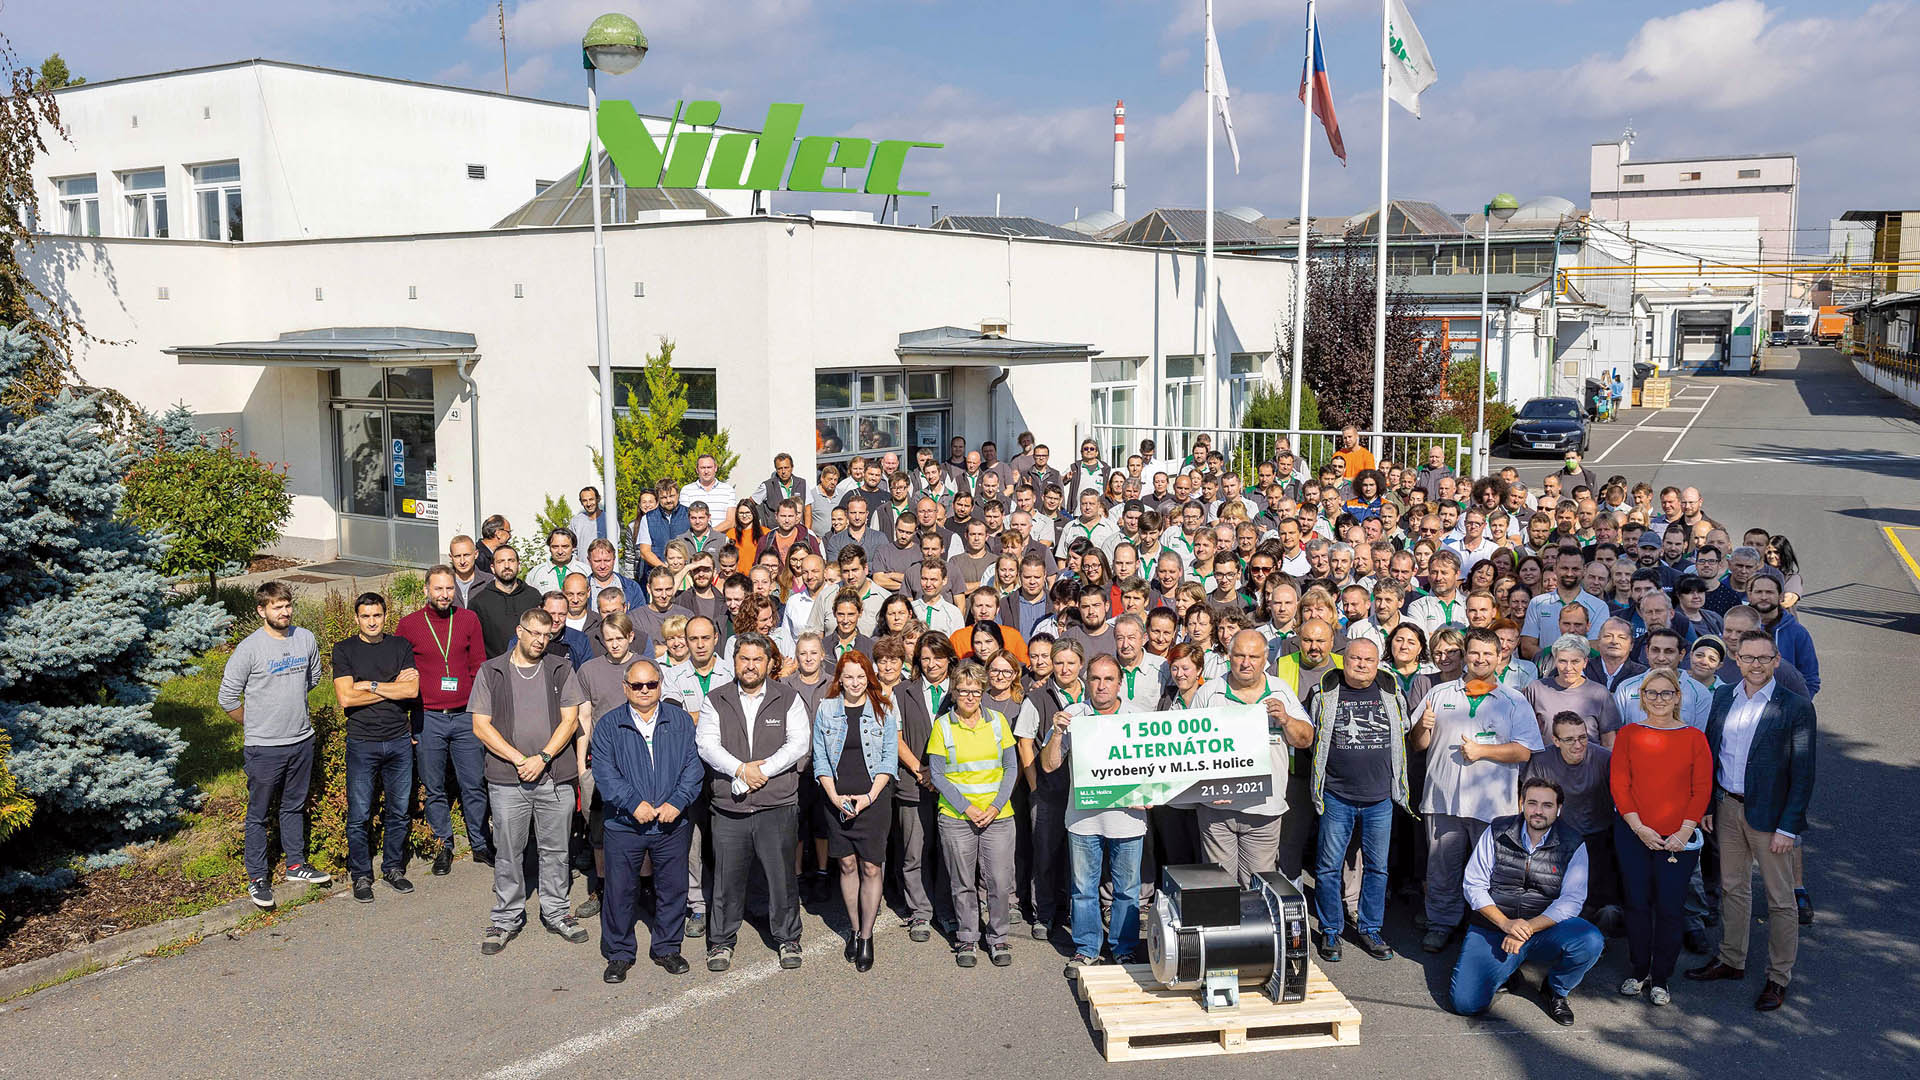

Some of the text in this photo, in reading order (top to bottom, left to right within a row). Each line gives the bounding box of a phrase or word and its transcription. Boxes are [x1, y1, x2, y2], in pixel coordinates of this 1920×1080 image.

[576, 100, 945, 197] Nidec
[451, 410, 459, 418] 43
[1122, 717, 1219, 738] 1 500 000.
[1108, 736, 1235, 760] ALTERNÁTOR
[1091, 757, 1254, 780] vyrobený v M.L.S. Holice
[1201, 782, 1264, 797] 21. 9. 2021
